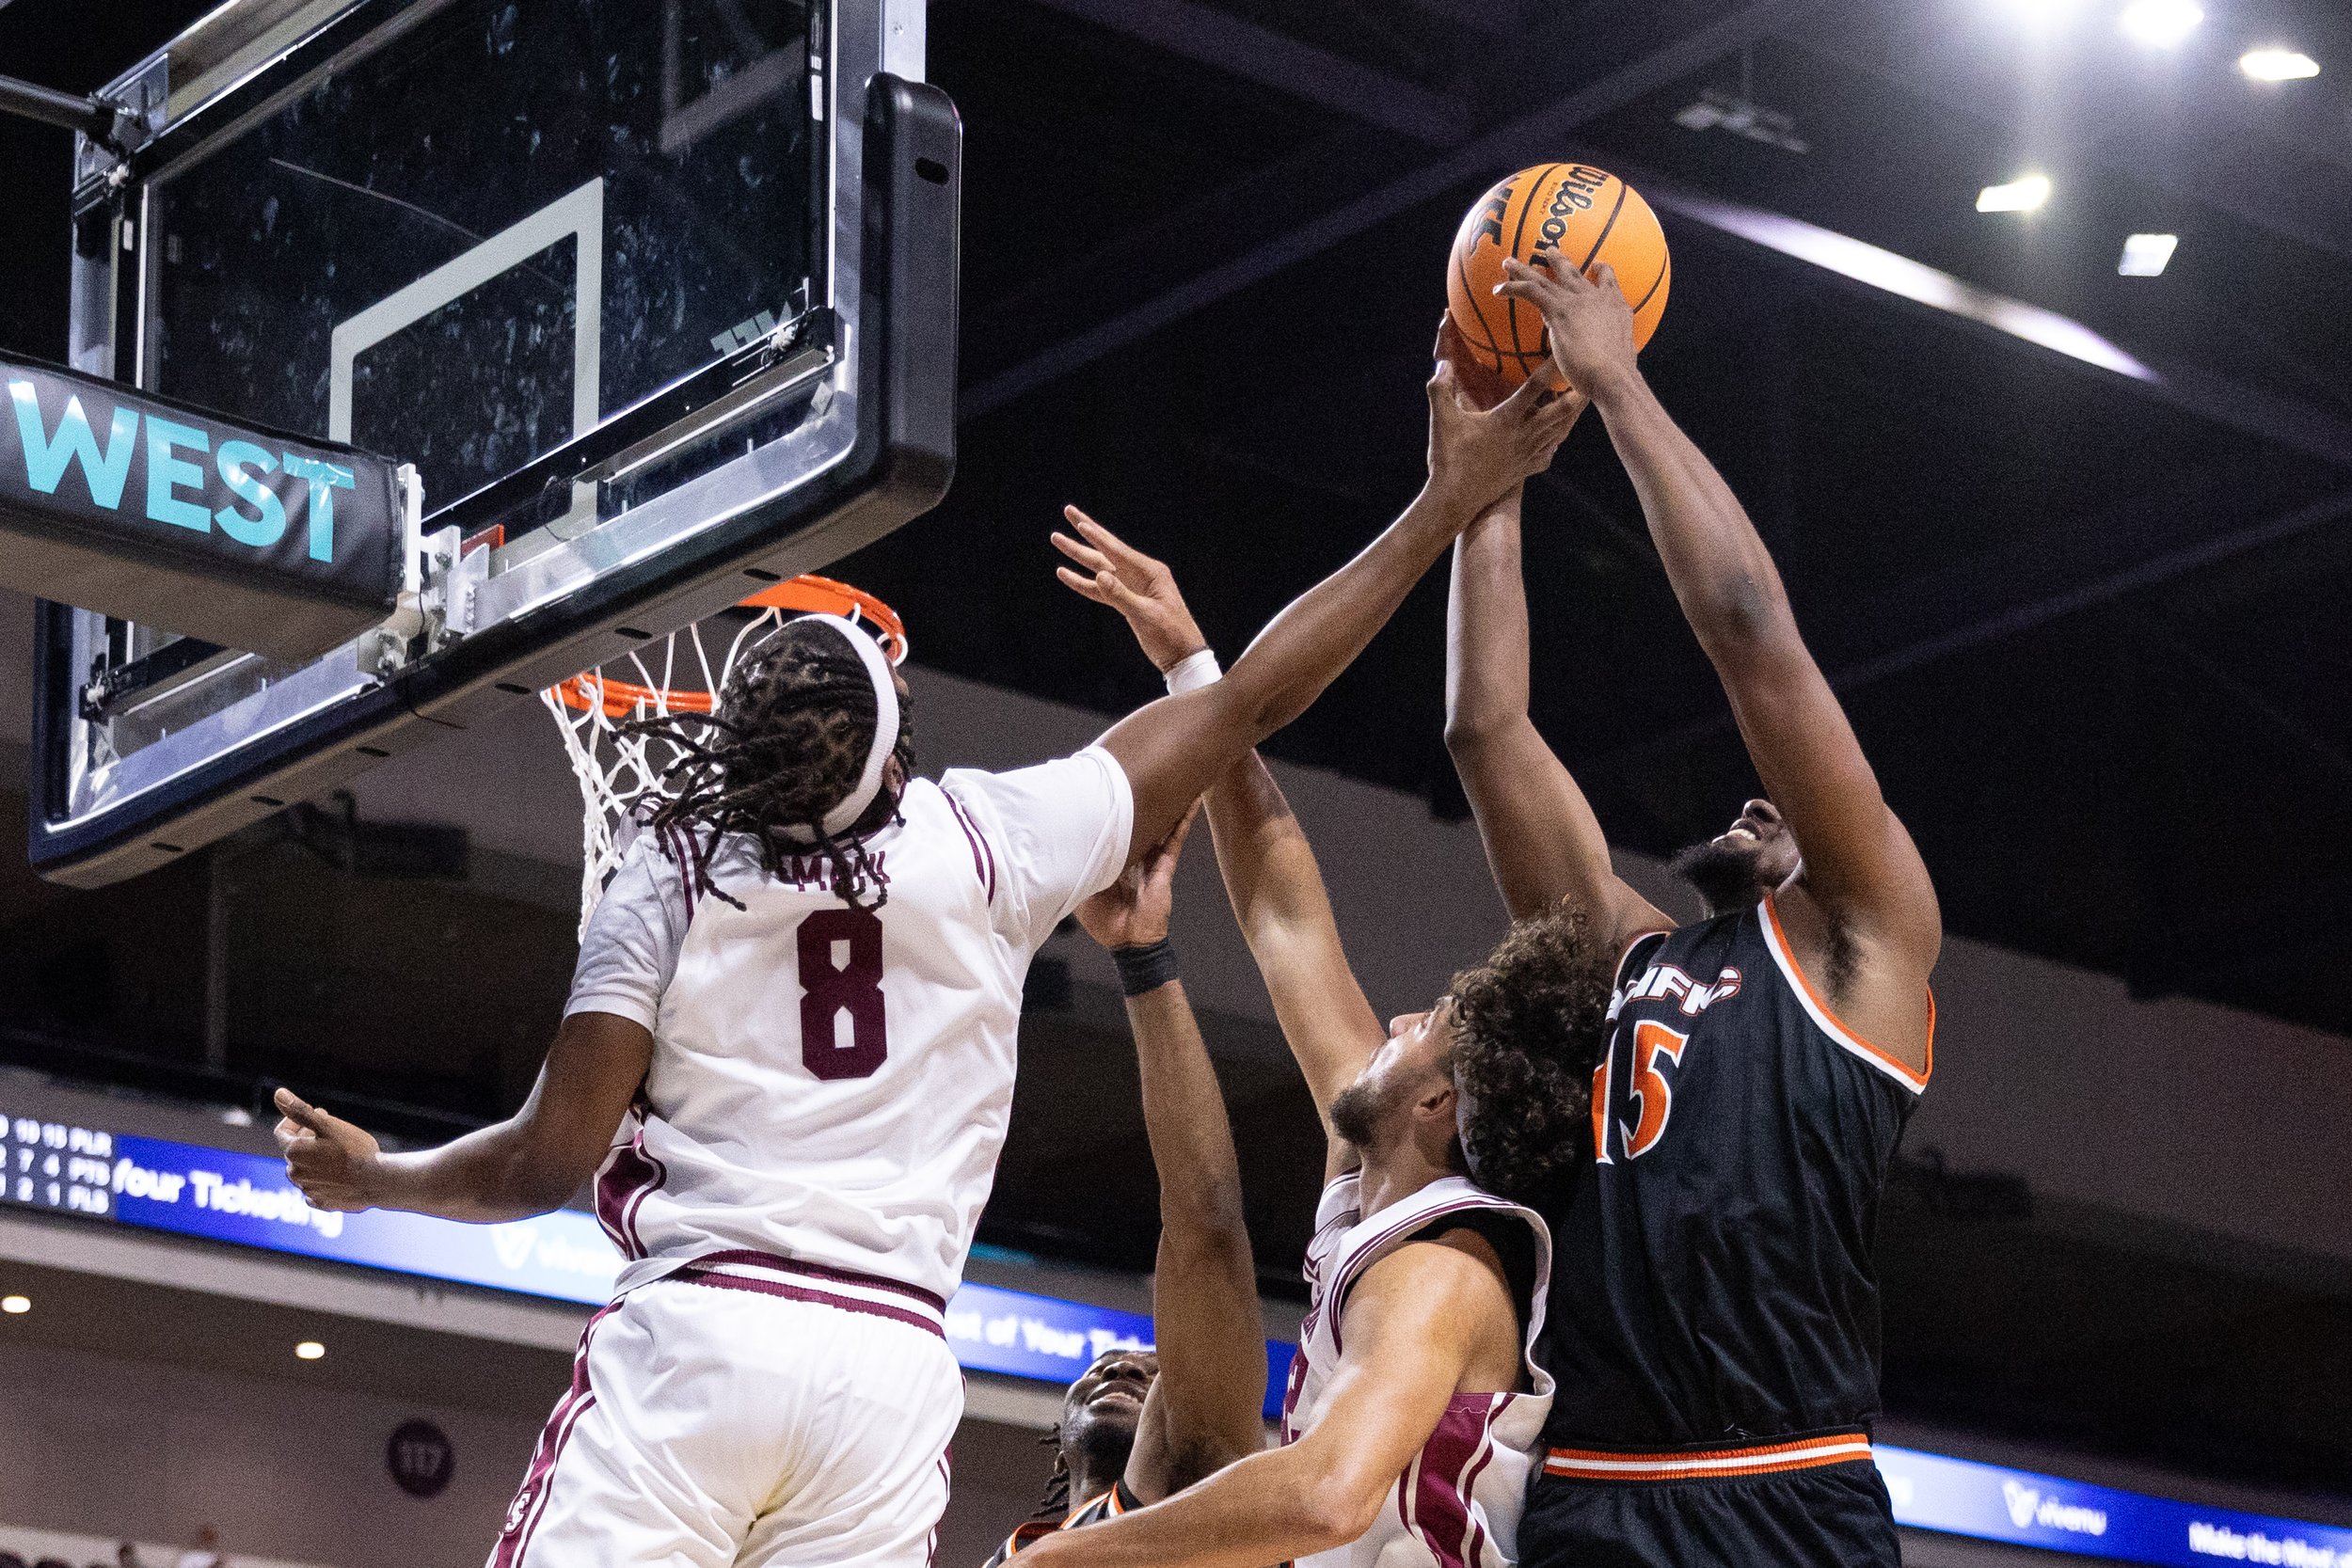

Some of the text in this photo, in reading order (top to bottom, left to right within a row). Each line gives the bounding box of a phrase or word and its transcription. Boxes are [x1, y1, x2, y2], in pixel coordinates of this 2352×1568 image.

[8, 379, 356, 563] WEST
[797, 909, 888, 1081] 8
[1591, 1019, 1691, 1165] 15
